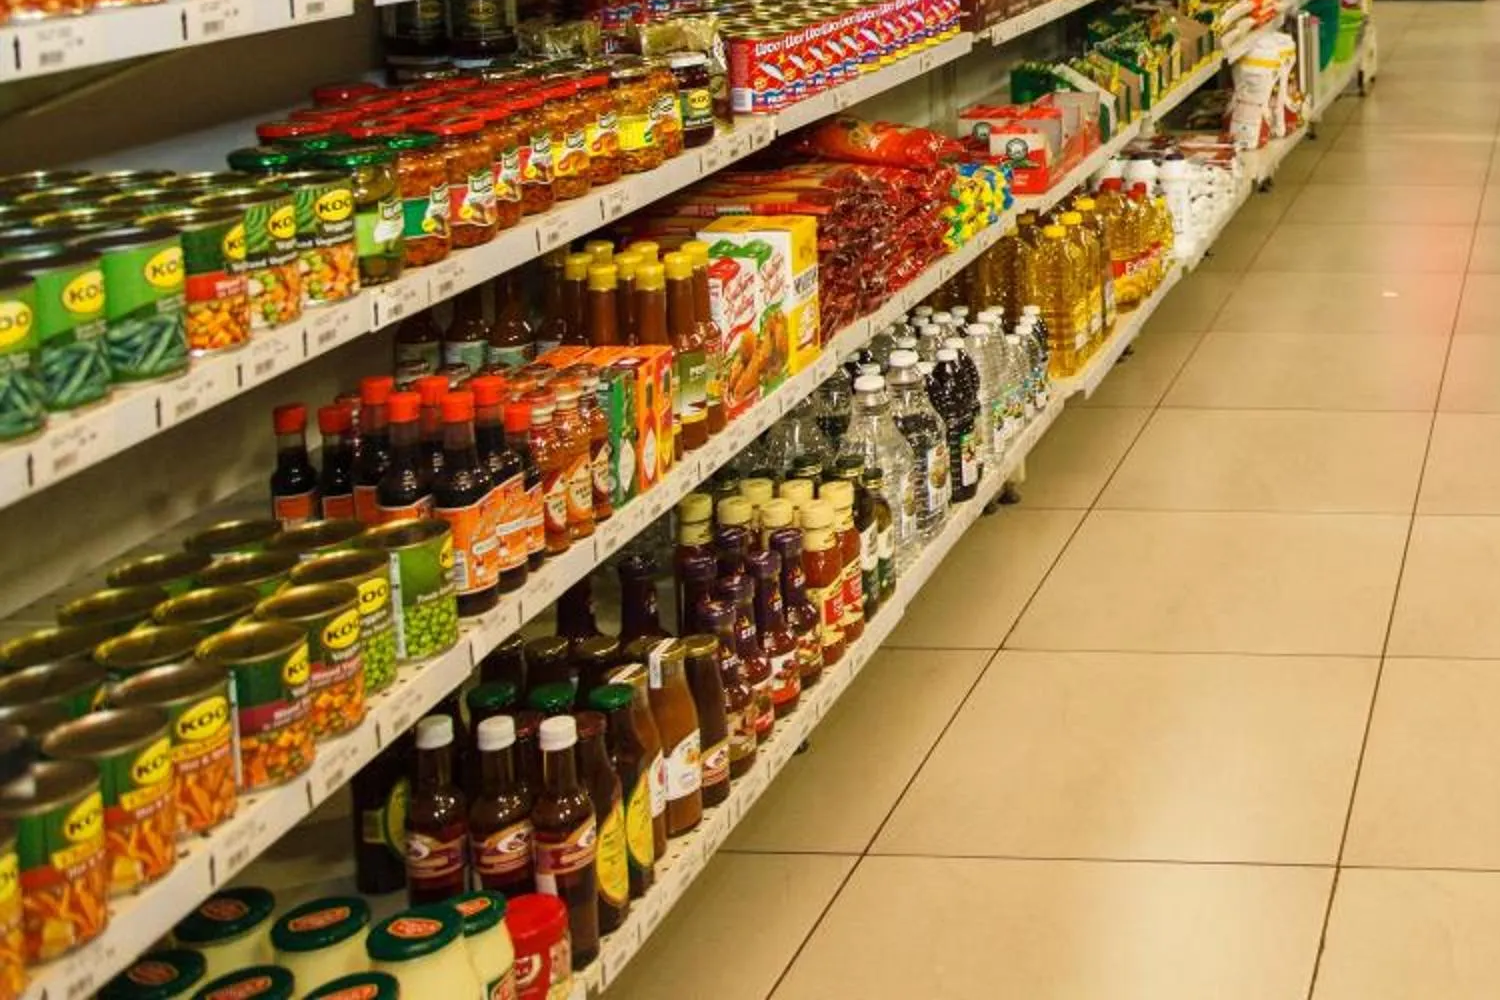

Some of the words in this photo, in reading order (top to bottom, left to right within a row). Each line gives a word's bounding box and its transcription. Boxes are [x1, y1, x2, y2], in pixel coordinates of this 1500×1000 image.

[0, 311, 29, 330] OO
[180, 705, 226, 734] KOO
[136, 753, 168, 777] KO
